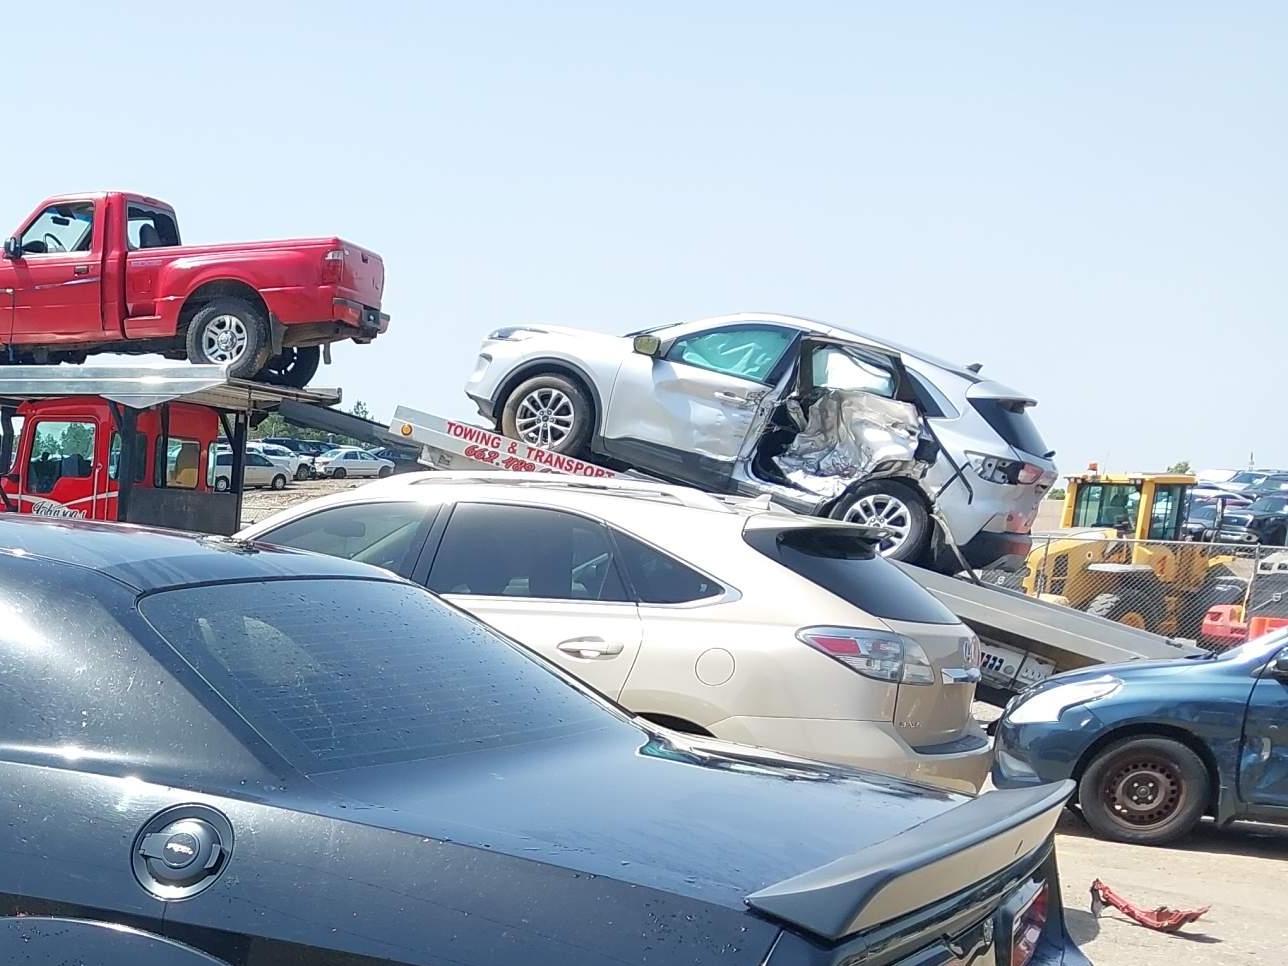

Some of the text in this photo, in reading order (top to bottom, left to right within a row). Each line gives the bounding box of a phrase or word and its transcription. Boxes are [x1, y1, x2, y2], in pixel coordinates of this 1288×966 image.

[447, 421, 615, 478] TOWING & TRANSPORT
